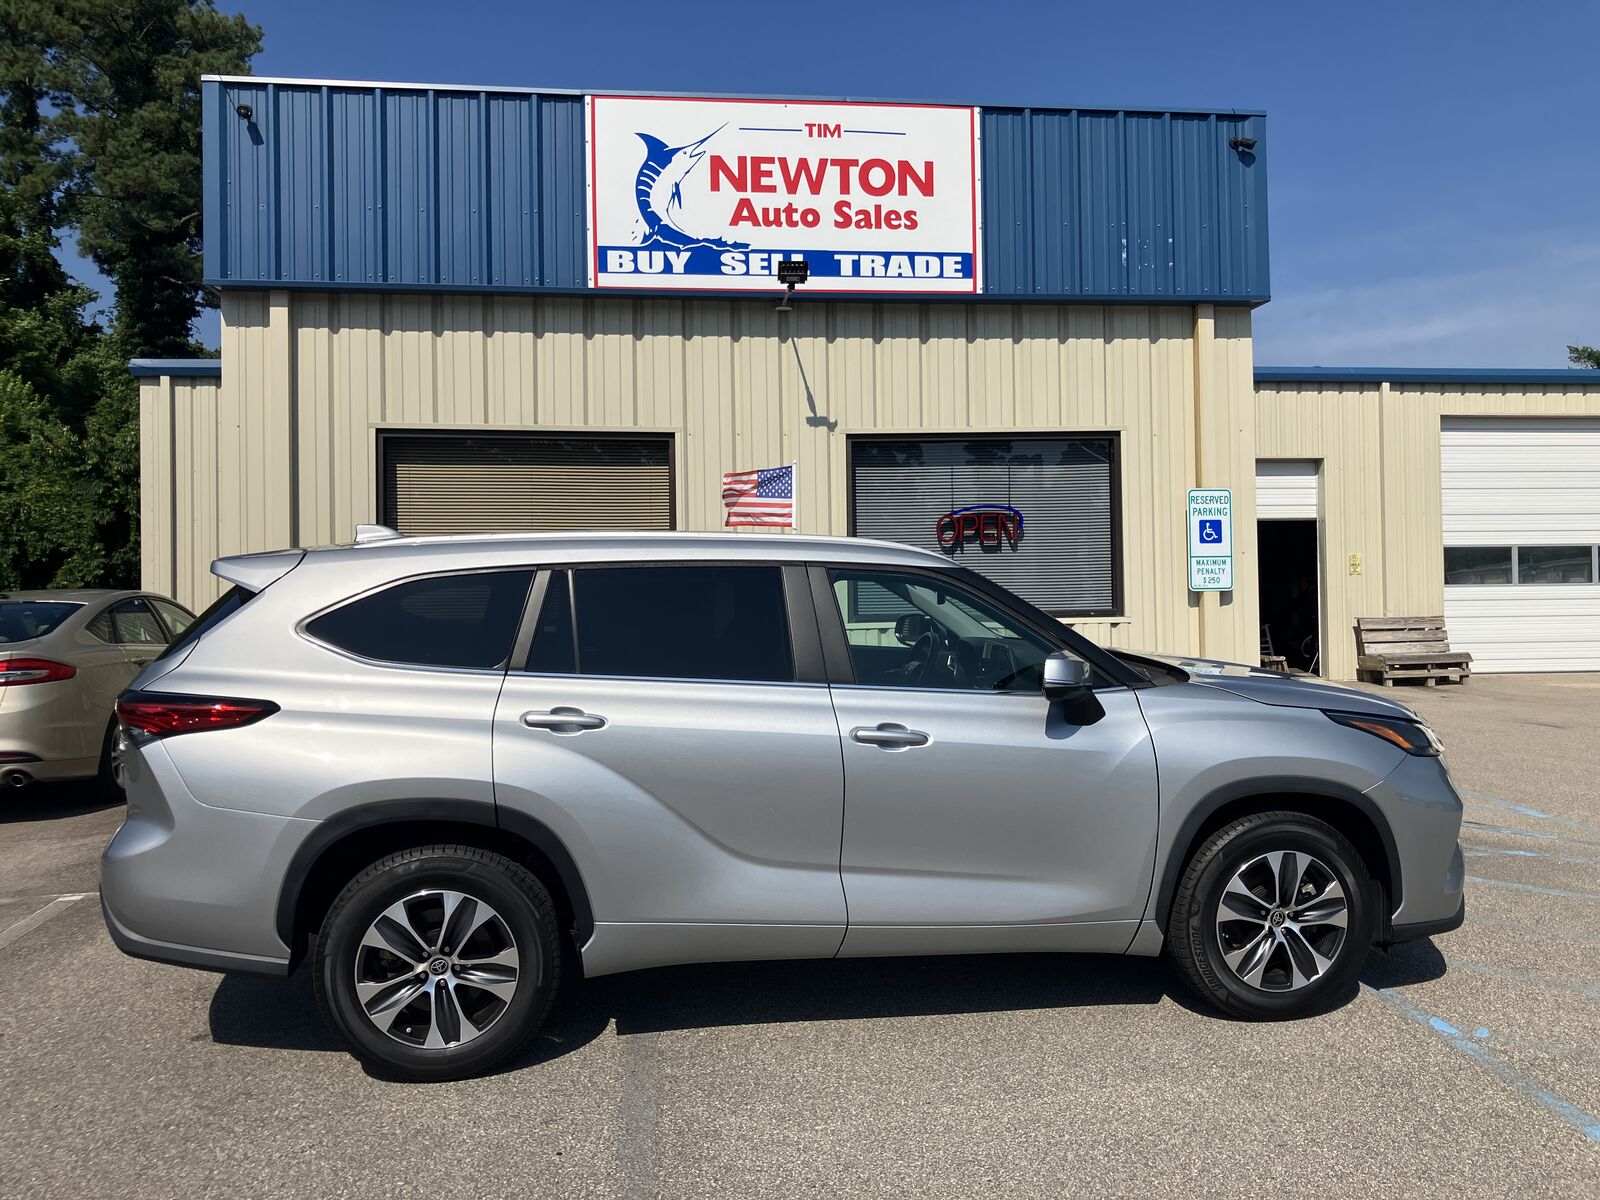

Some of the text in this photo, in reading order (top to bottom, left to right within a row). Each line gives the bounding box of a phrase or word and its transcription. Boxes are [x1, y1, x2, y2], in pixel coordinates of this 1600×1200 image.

[804, 122, 842, 139] TIM
[710, 154, 935, 198] NEWTON
[728, 198, 919, 231] Auto Sales
[606, 249, 693, 275] BUY
[833, 253, 964, 279] TRADE
[1190, 495, 1229, 505] RESERVED
[1192, 507, 1228, 517] PARKING
[936, 512, 1020, 543] OPEN
[1196, 567, 1226, 575] PENALTY
[1191, 924, 1225, 992] BRIDGESTONE
